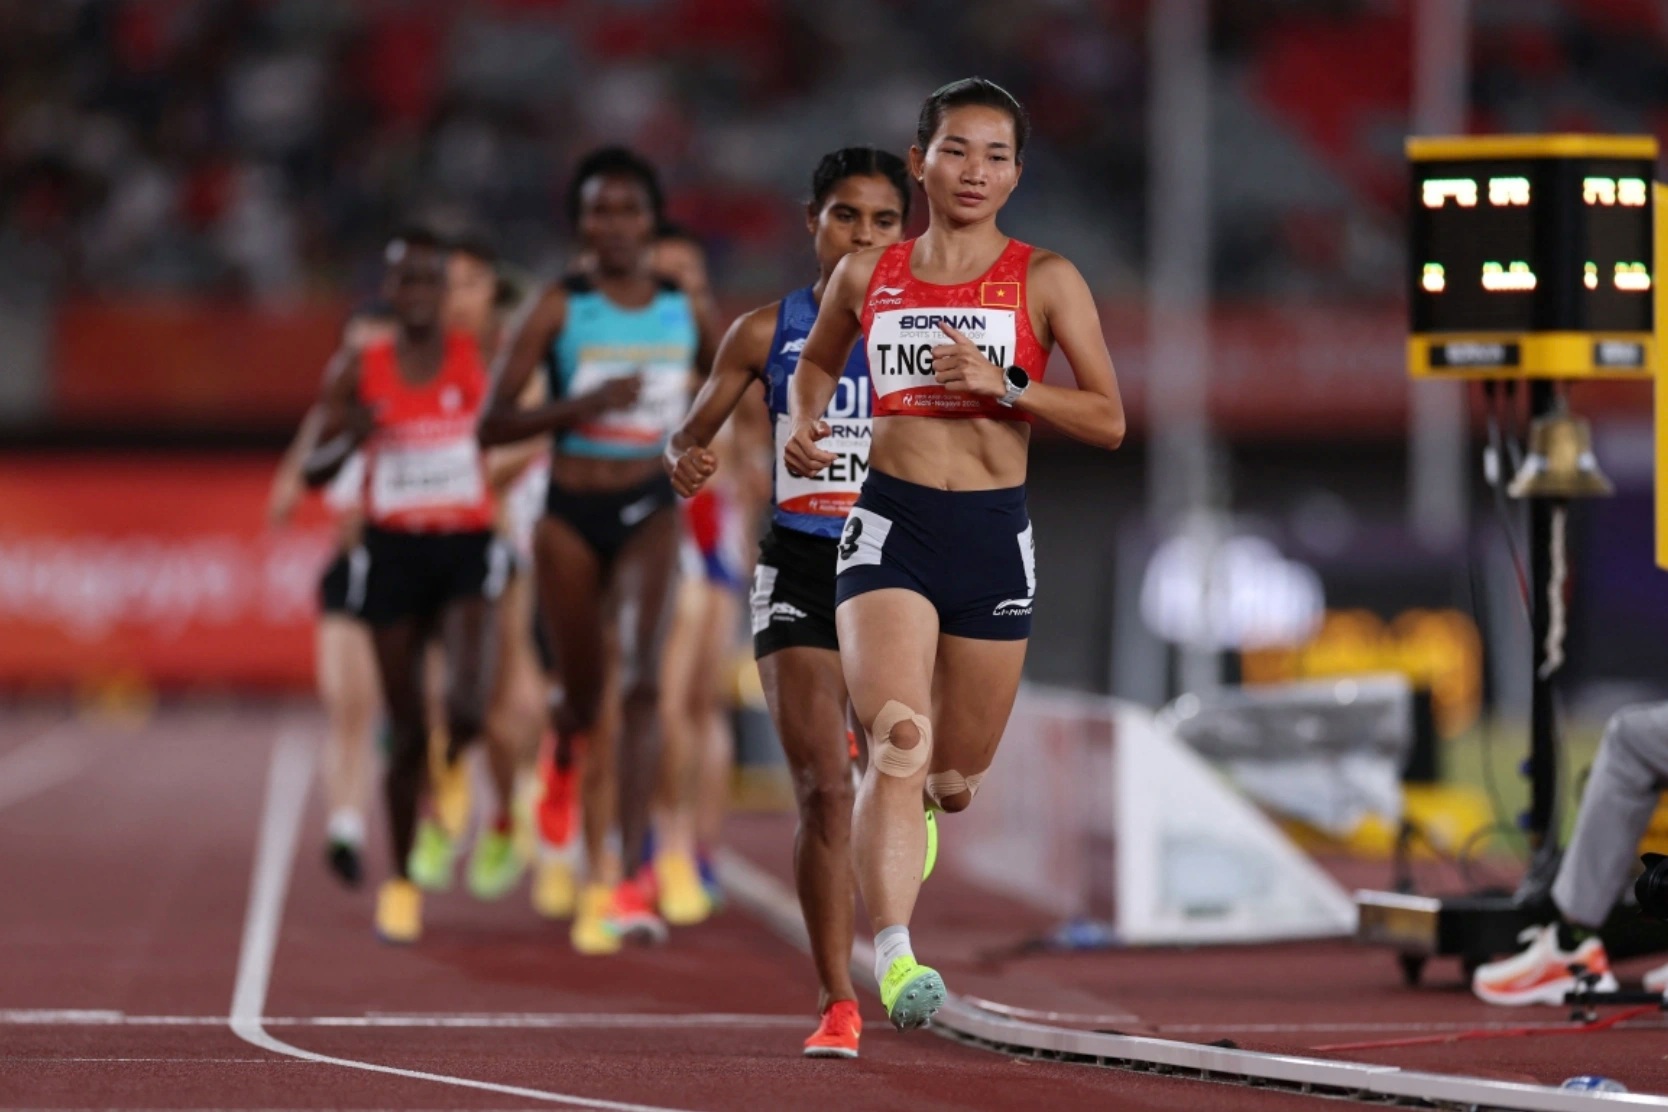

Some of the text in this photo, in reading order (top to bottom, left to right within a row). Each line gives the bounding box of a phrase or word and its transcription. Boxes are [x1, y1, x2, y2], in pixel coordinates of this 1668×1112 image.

[899, 315, 986, 330] BORNAN
[900, 331, 930, 339] SPORTS
[877, 344, 1005, 375] T.NGN
[839, 516, 863, 560] 3
